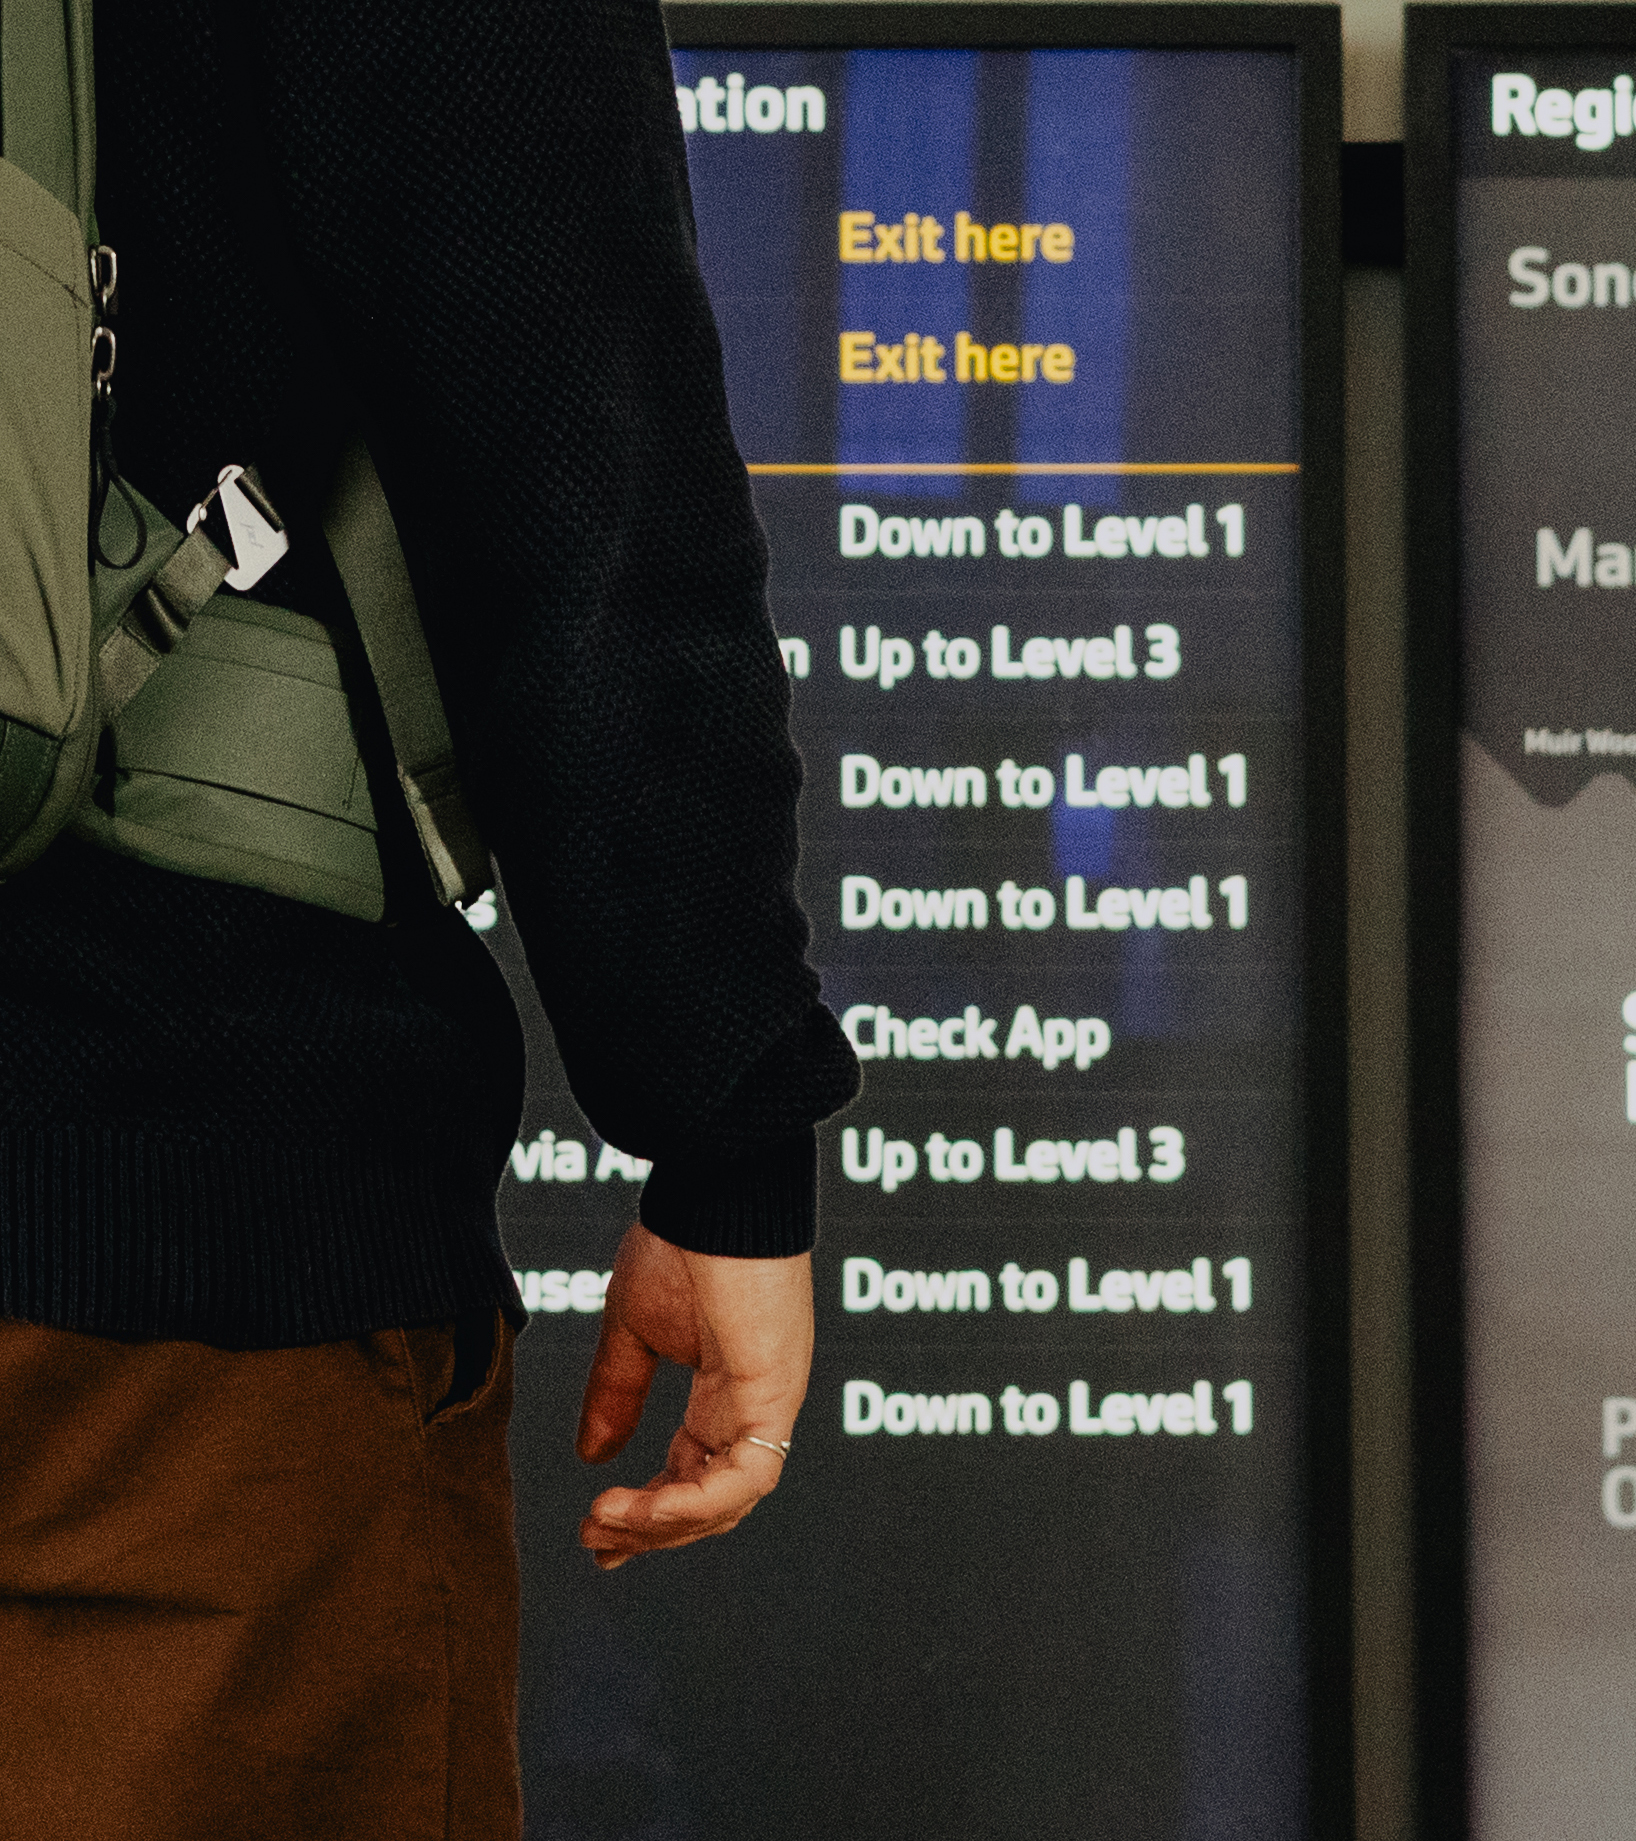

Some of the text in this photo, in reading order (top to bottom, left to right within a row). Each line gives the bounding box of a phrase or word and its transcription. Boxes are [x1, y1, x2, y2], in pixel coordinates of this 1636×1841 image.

[840, 211, 1076, 264] Exit here
[841, 331, 1076, 384] Exit here
[840, 502, 1244, 558] Down to Level 1
[840, 625, 914, 689] Up
[922, 630, 981, 679] to
[991, 625, 1137, 679] Level
[1144, 623, 1181, 679] 3
[841, 753, 1247, 808] Down to Level 1
[841, 874, 1248, 930] Down to Level 1
[841, 1004, 1111, 1070] Check App
[842, 1126, 1186, 1192] Up to Level 3
[843, 1257, 1252, 1313] Down to Level 1
[843, 1380, 1253, 1436] Down to Level 1
